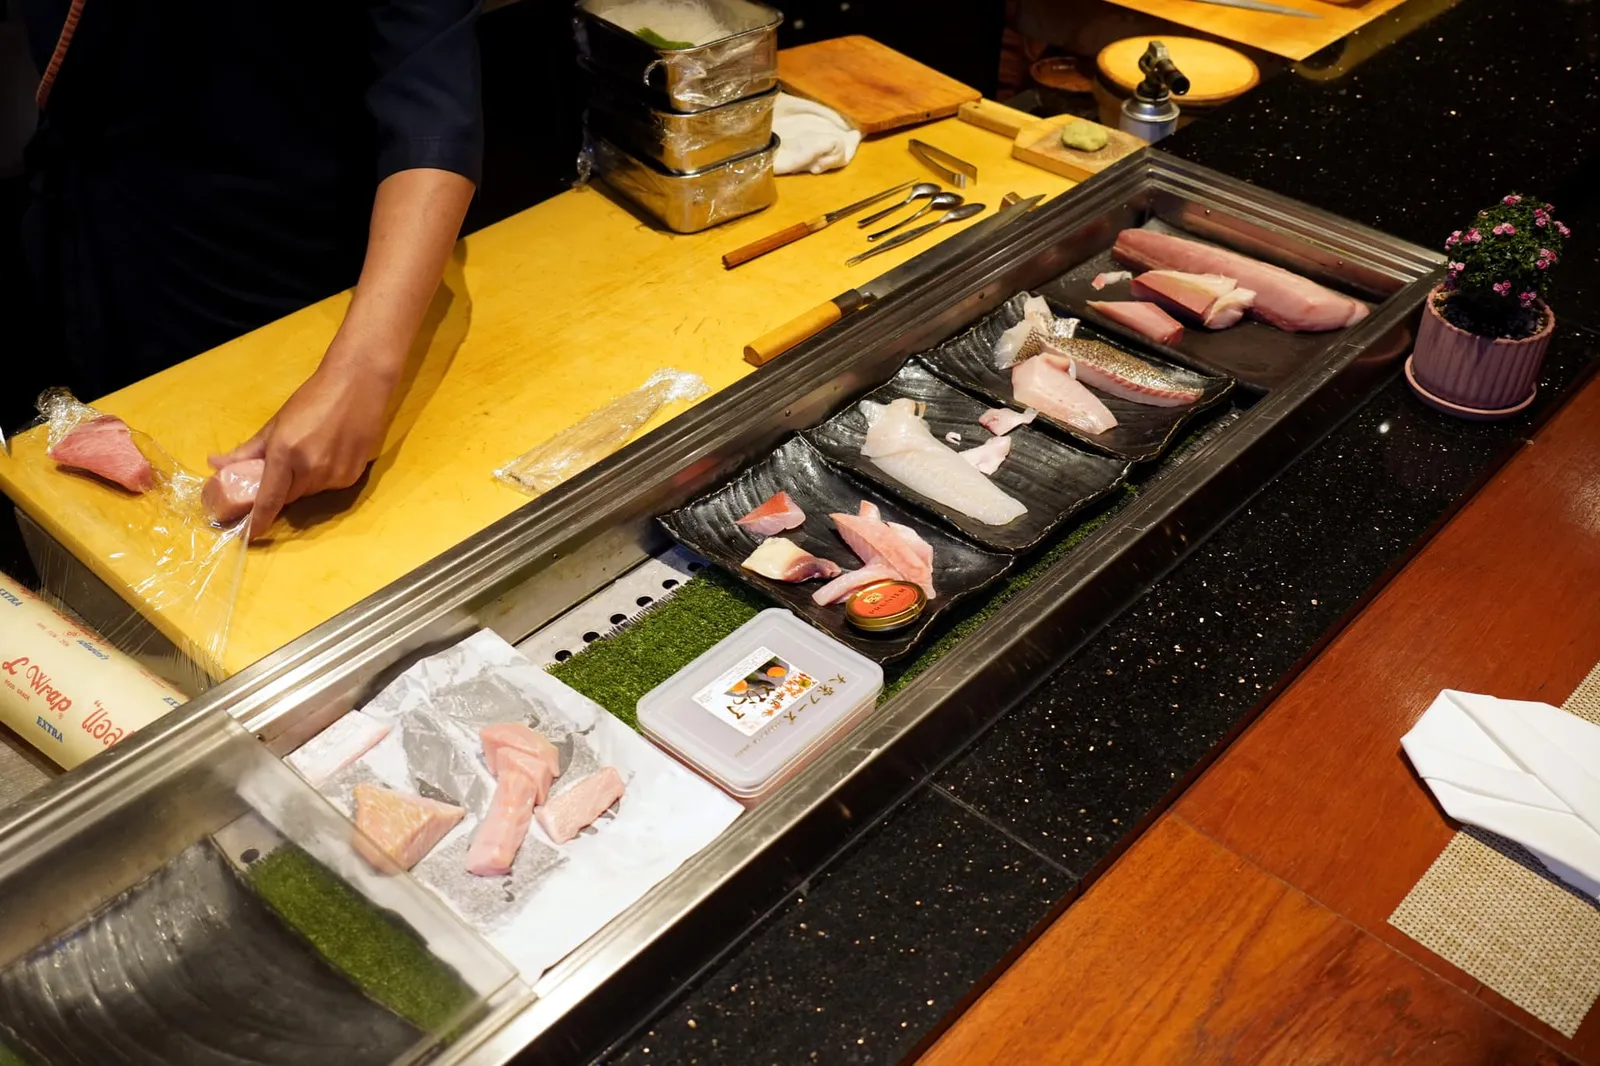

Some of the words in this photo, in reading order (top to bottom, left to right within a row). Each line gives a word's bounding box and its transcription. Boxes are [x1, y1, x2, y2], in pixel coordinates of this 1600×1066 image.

[2, 656, 29, 675] L
[26, 665, 72, 714] Wrap
[36, 715, 63, 743] EXTRA
